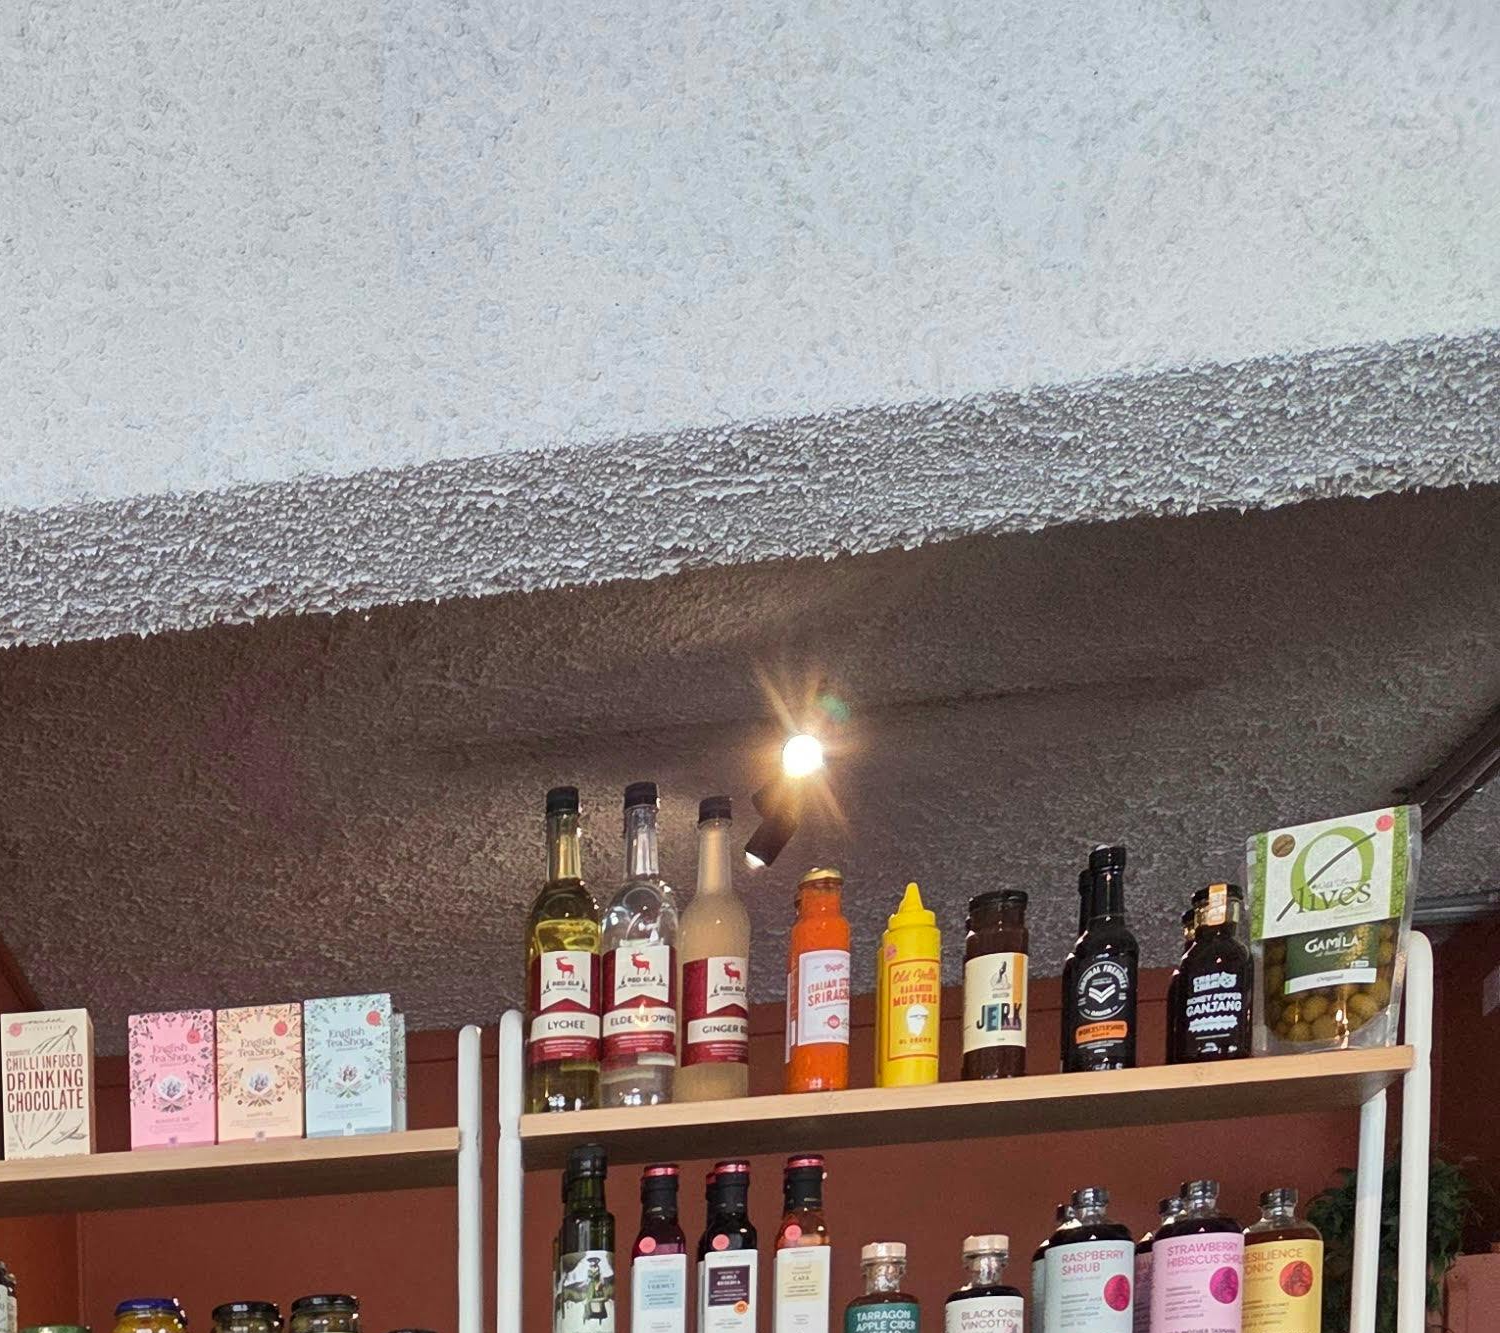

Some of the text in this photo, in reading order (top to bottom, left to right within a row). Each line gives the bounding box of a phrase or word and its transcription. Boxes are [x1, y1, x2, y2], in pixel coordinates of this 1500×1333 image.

[808, 978, 838, 994] ITALIAN
[1185, 1001, 1242, 1018] GANJANG
[976, 1002, 1023, 1033] JERK
[547, 1019, 586, 1031] LYCHEE
[702, 1023, 739, 1035] GINGER
[328, 1028, 366, 1042] English
[240, 1037, 277, 1050] English
[5, 1053, 84, 1071] CHILLI INFUSED
[6, 1067, 84, 1091] DRINKING
[6, 1088, 84, 1113] CHOCOLATE
[1061, 1249, 1125, 1264] RASPBERRY
[1166, 1242, 1239, 1257] STRAWBERRY
[1166, 1253, 1221, 1268] HIBISCUS
[1061, 1262, 1102, 1276] SHRUB
[856, 1309, 911, 1322] TARRAGON
[961, 1309, 995, 1321] BLACK
[856, 1320, 916, 1332] APPLE CIDER
[961, 1320, 1014, 1331] VINCOTTO
